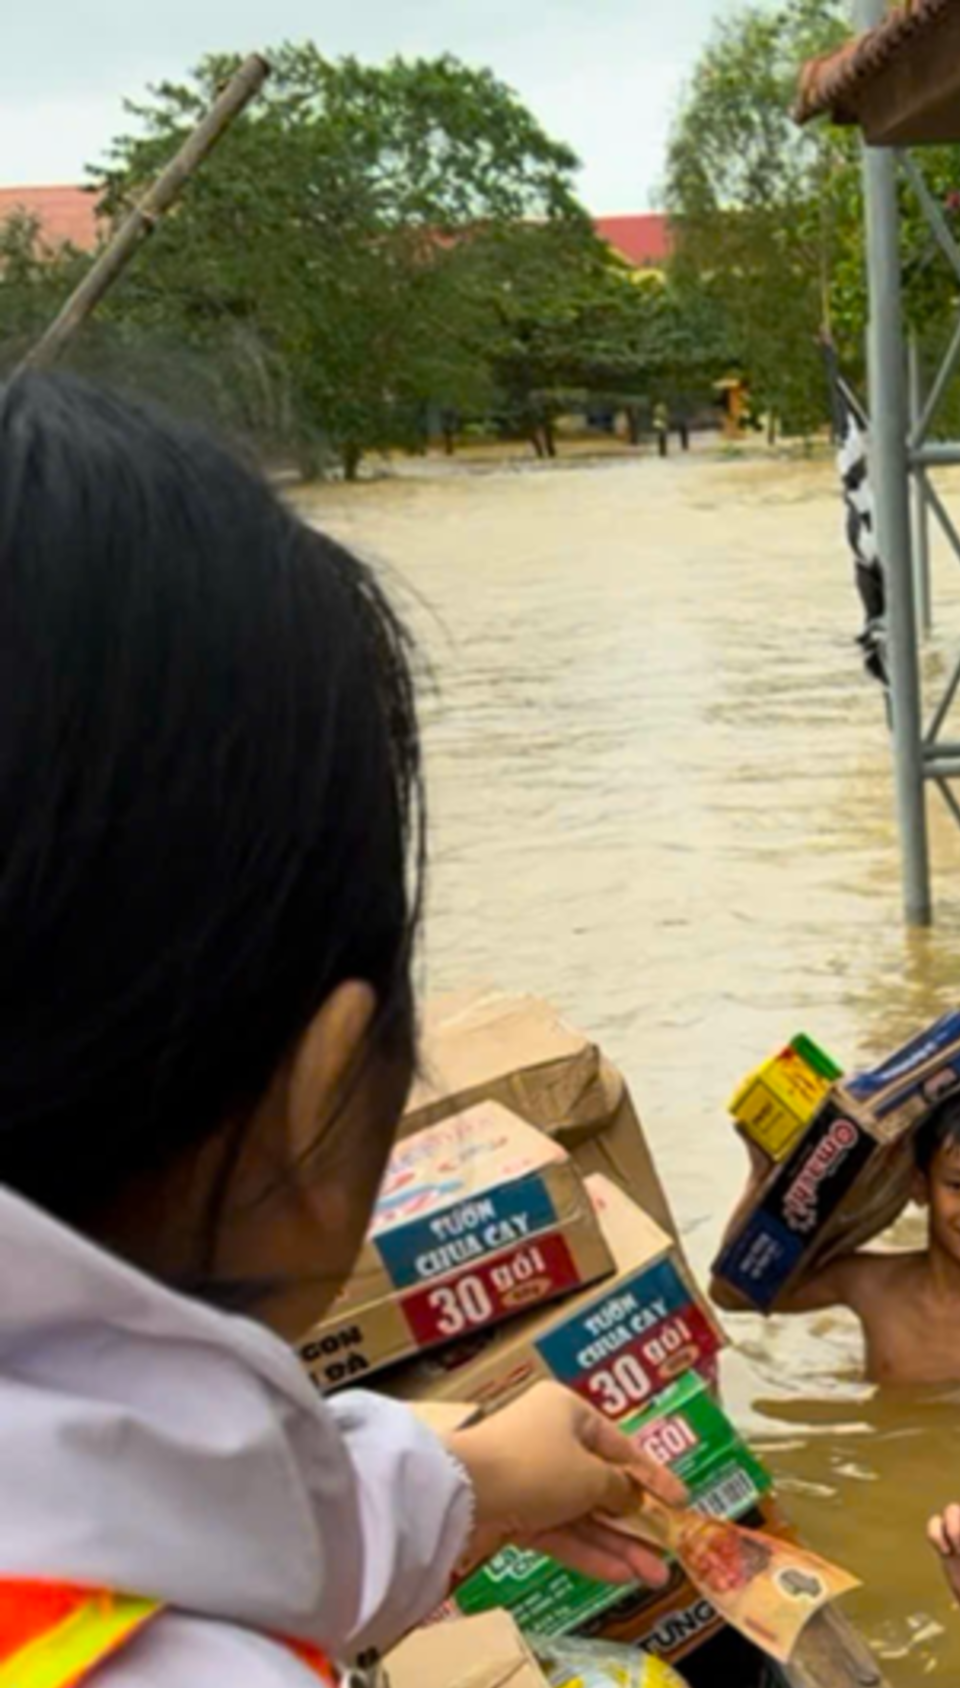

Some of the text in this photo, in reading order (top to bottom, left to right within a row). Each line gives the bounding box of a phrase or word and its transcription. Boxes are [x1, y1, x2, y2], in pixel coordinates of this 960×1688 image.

[484, 1211, 530, 1248] CAY
[429, 1246, 546, 1335] 30 gói
[629, 1296, 670, 1334] CAY
[300, 1325, 364, 1363] GON
[588, 1354, 651, 1415] 30
[642, 1316, 693, 1366] gói
